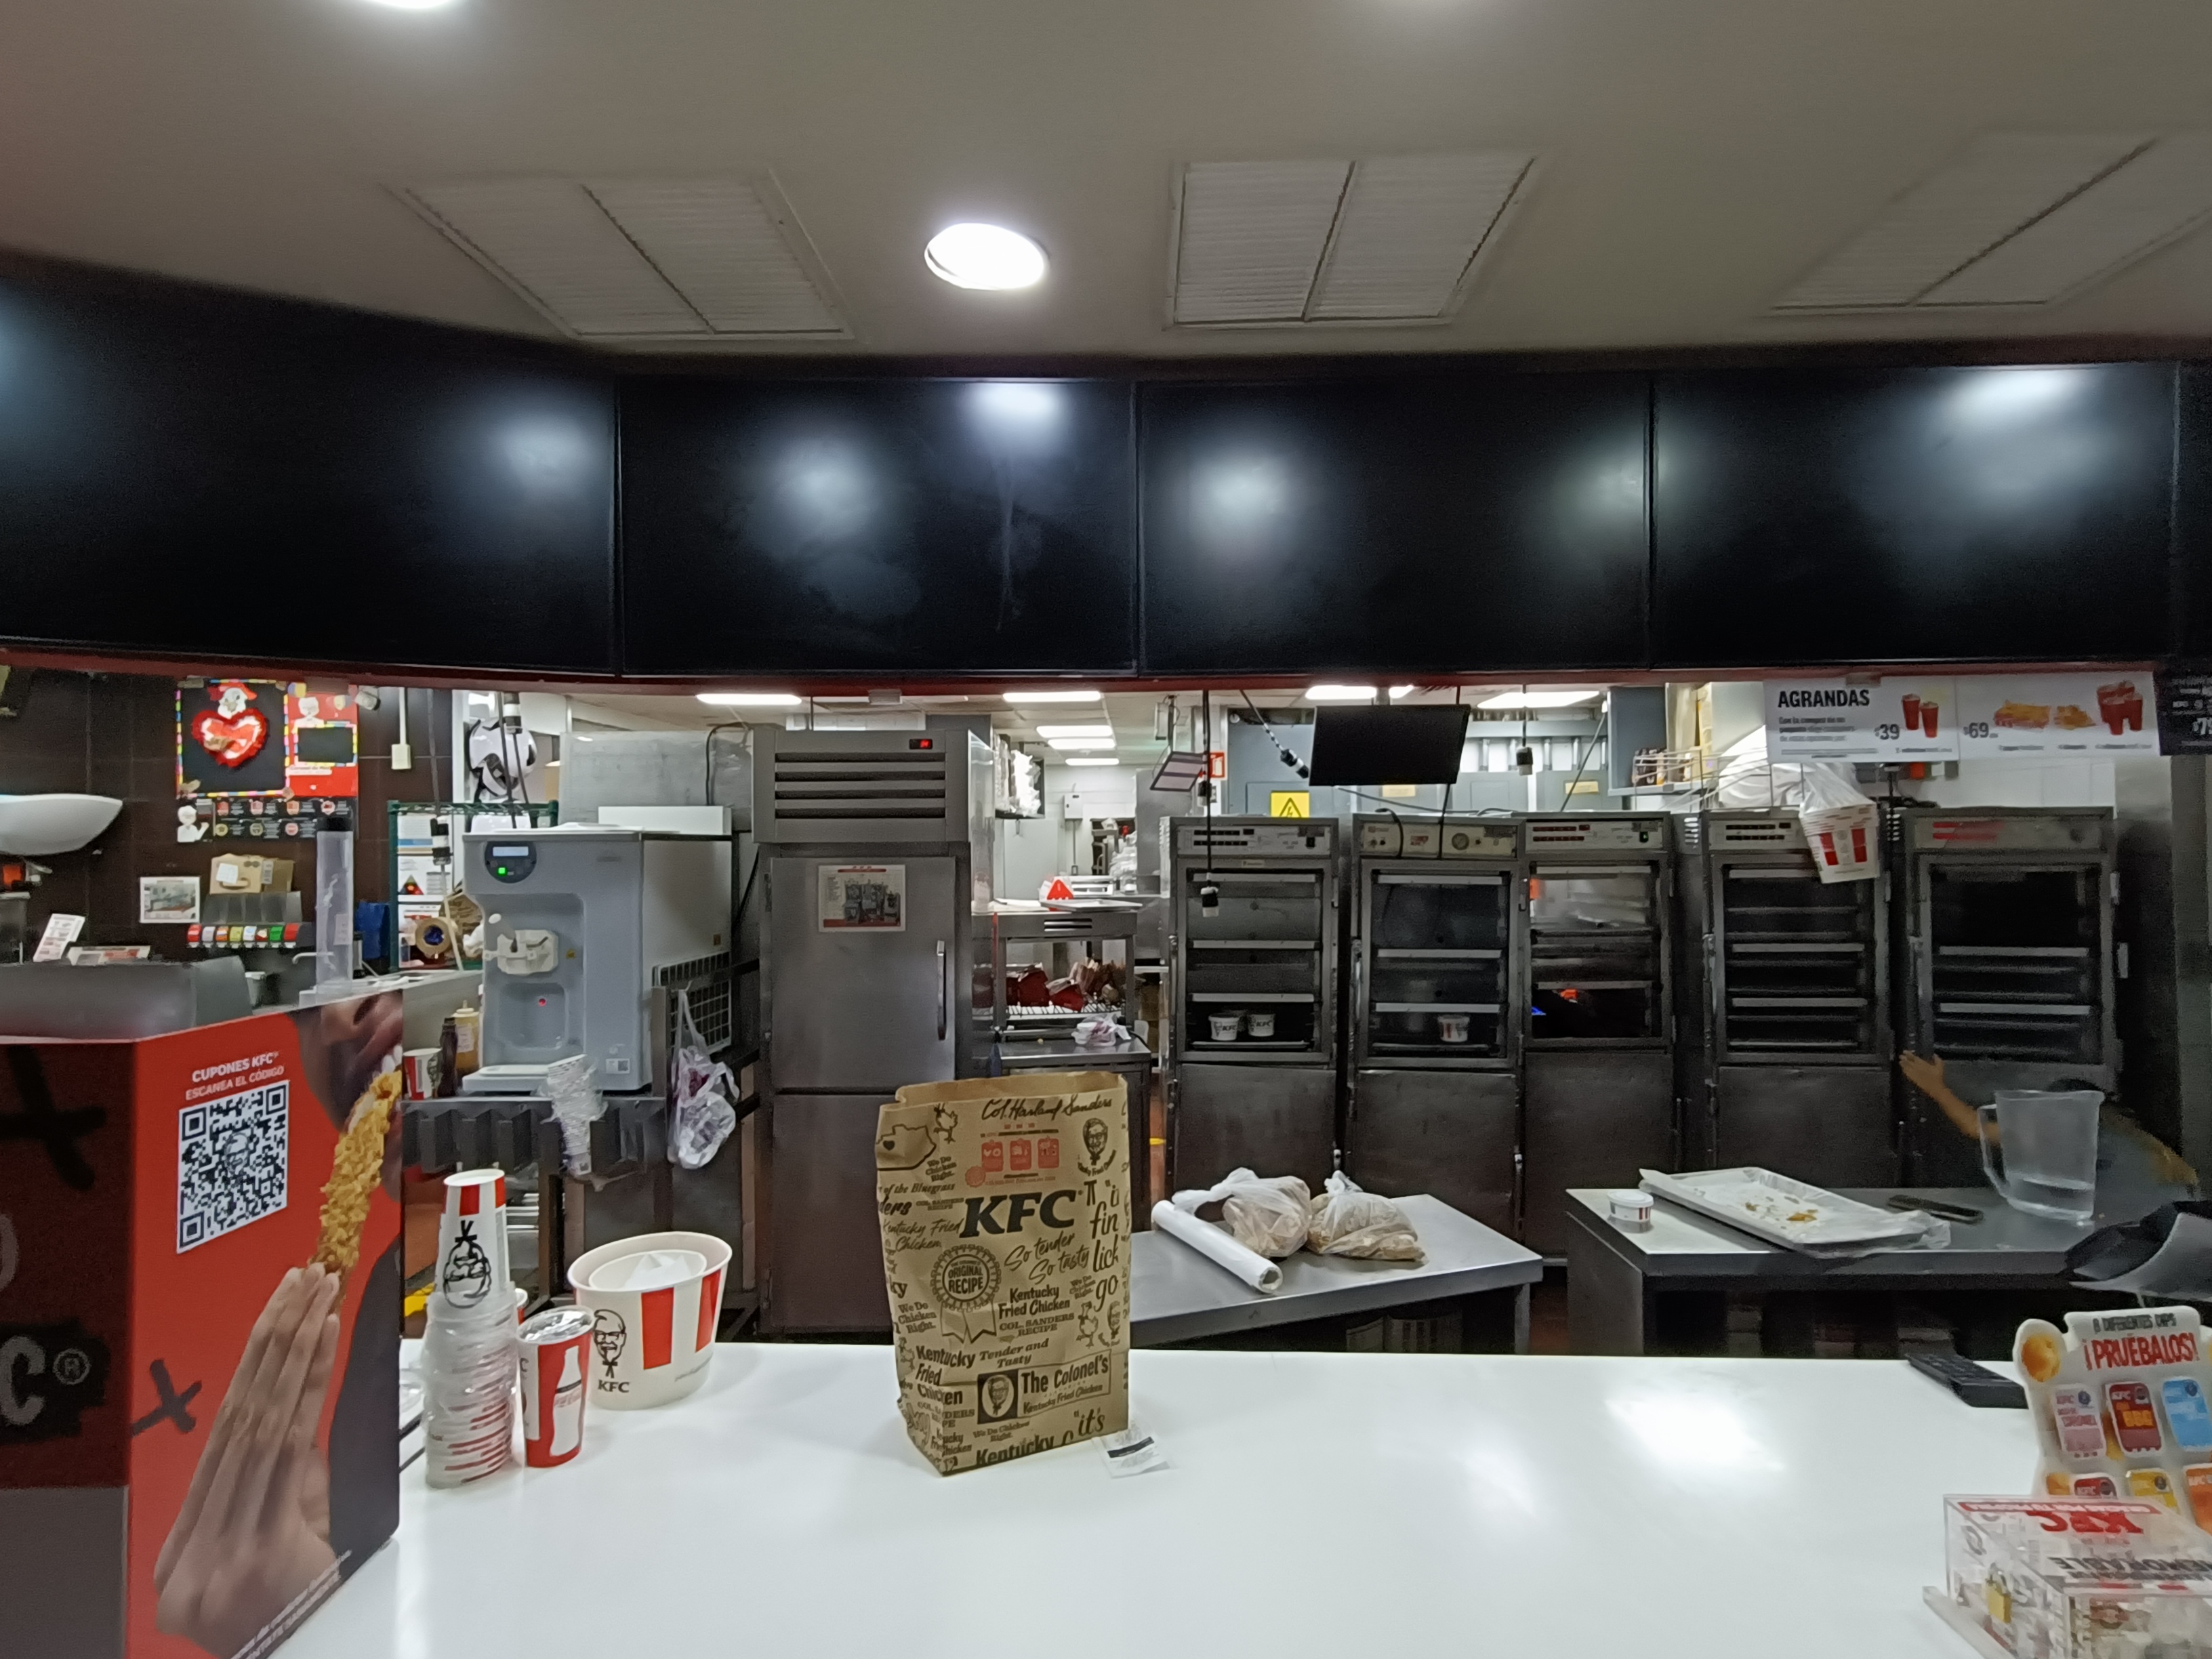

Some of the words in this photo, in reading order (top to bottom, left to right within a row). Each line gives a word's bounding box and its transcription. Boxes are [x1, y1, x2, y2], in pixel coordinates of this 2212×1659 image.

[1778, 690, 1870, 708] AGRANDAS
[192, 1058, 250, 1083] CUPONES
[186, 1079, 234, 1101] ESCANEA
[235, 1076, 247, 1087] EL
[959, 1190, 1078, 1239] KFC
[930, 1218, 964, 1237] Fried
[1004, 1245, 1032, 1271] So
[1034, 1230, 1076, 1260] tender
[948, 1265, 983, 1279] ORIGINAL
[1029, 1258, 1056, 1285] So
[1058, 1244, 1090, 1273] tasty
[948, 1277, 983, 1294] RECIPE
[1010, 1284, 1059, 1304] Kentucky
[898, 1303, 914, 1313] We
[914, 1301, 929, 1310] Do
[998, 1303, 1027, 1319] Fried
[1029, 1299, 1071, 1315] Chicken
[898, 1311, 937, 1324] Chicken
[999, 1322, 1024, 1331] COL.
[1025, 1313, 1075, 1328] SANDERS
[1017, 1324, 1058, 1336] RECIPE
[916, 1345, 976, 1369] Kentucky
[979, 1346, 1024, 1362] Tender
[1025, 1338, 1050, 1351] and
[997, 1355, 1032, 1369] Tasty
[915, 1363, 943, 1387] Fried
[1021, 1370, 1049, 1394] The
[1053, 1354, 1109, 1389] Colonel's
[598, 1379, 631, 1393] KFC
[1057, 1389, 1075, 1404] Fried
[976, 1433, 1054, 1465] Kentucky
